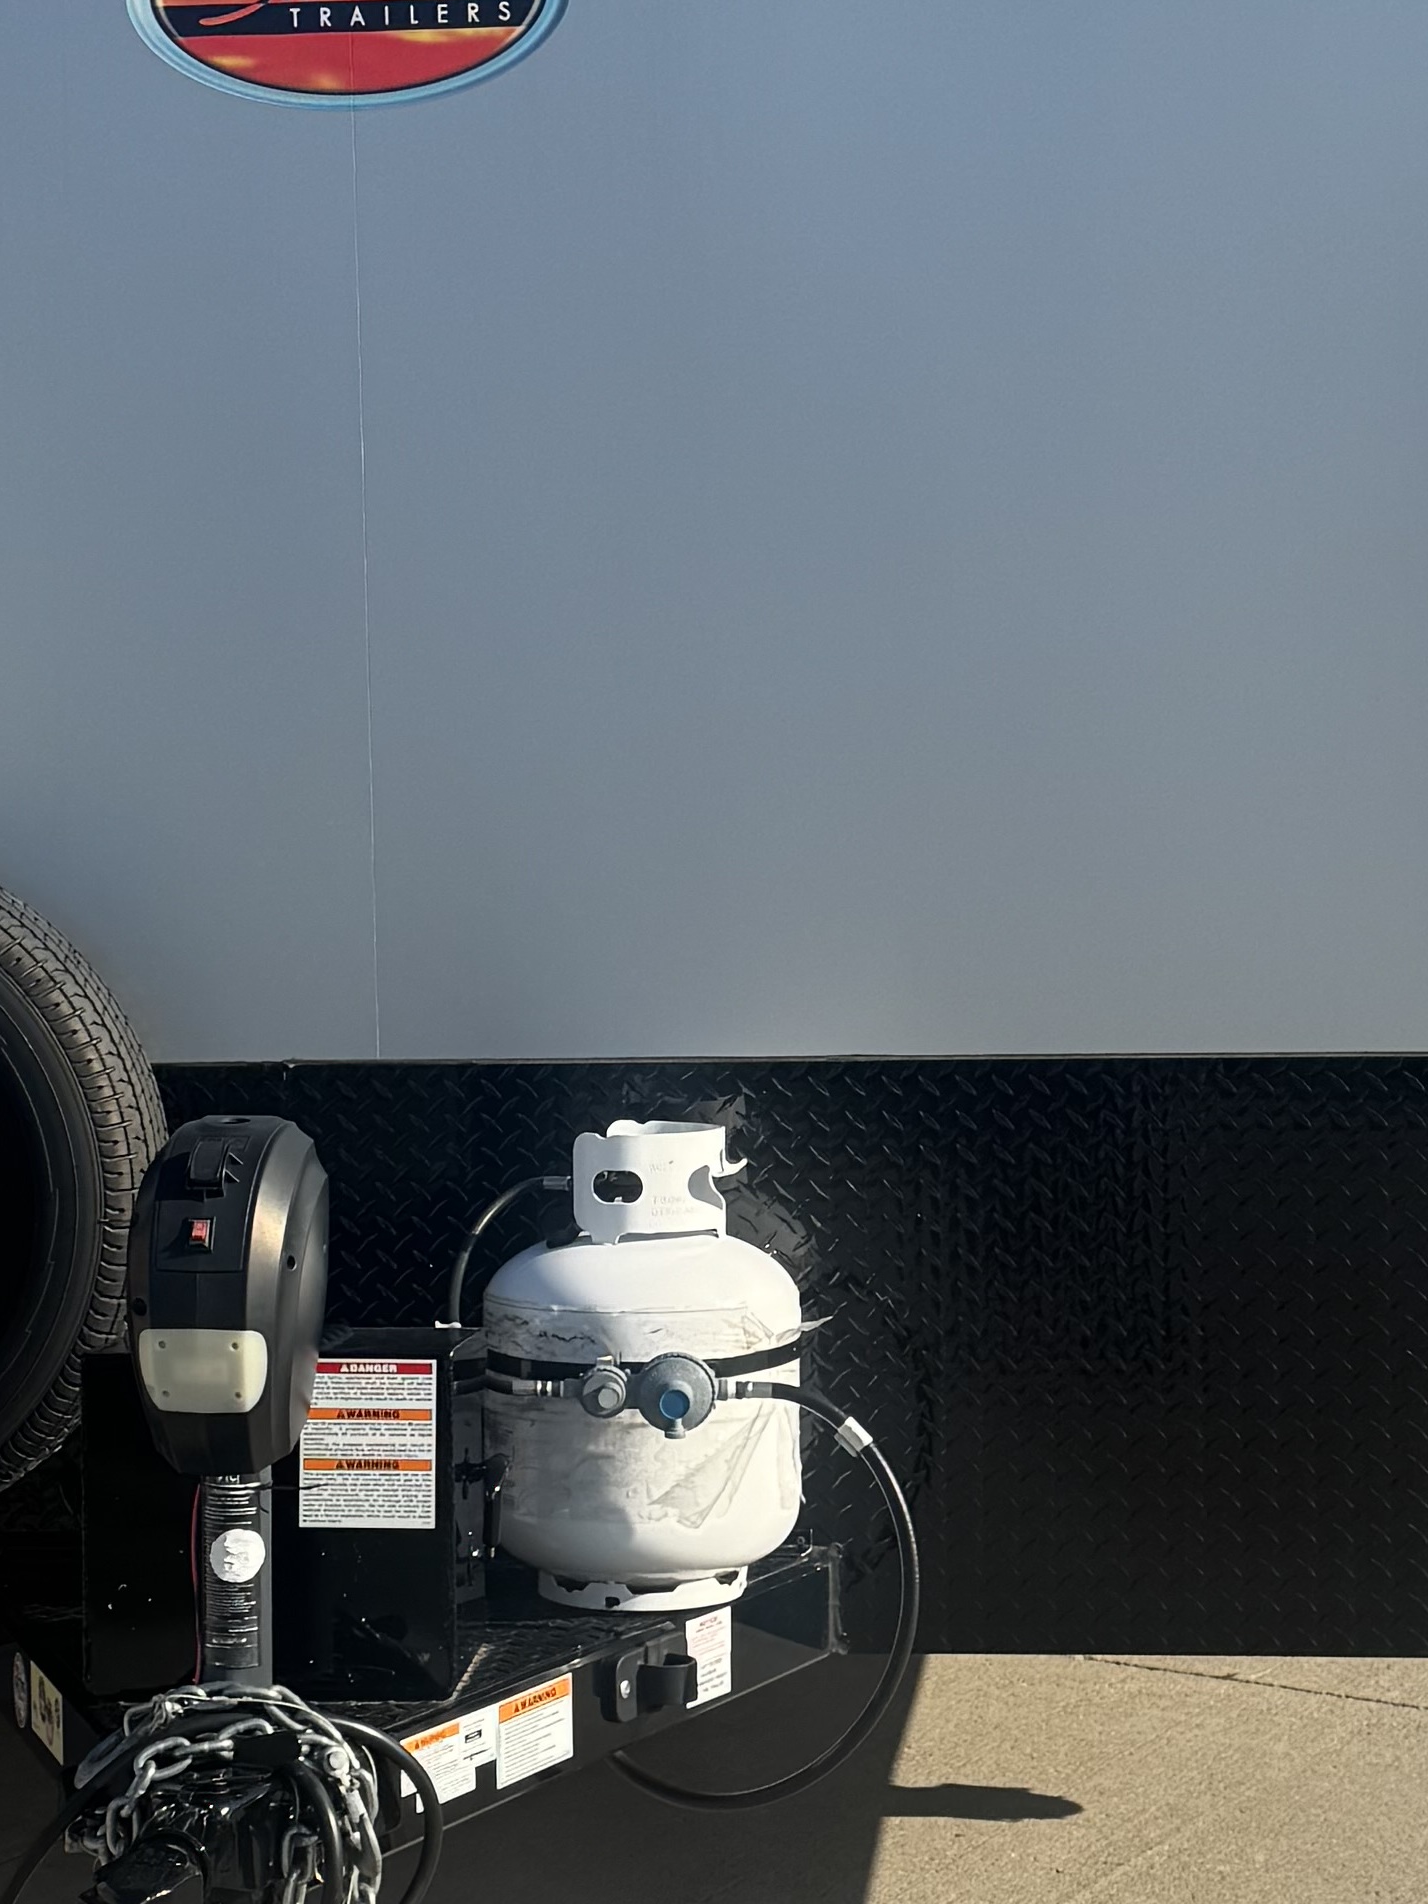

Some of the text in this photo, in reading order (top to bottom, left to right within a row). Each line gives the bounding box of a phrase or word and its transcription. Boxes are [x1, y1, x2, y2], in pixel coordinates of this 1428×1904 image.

[289, 0, 512, 29] TRAILERS
[350, 1363, 398, 1373] DANGER
[347, 1409, 400, 1419] WARNING
[346, 1460, 400, 1470] WARNING
